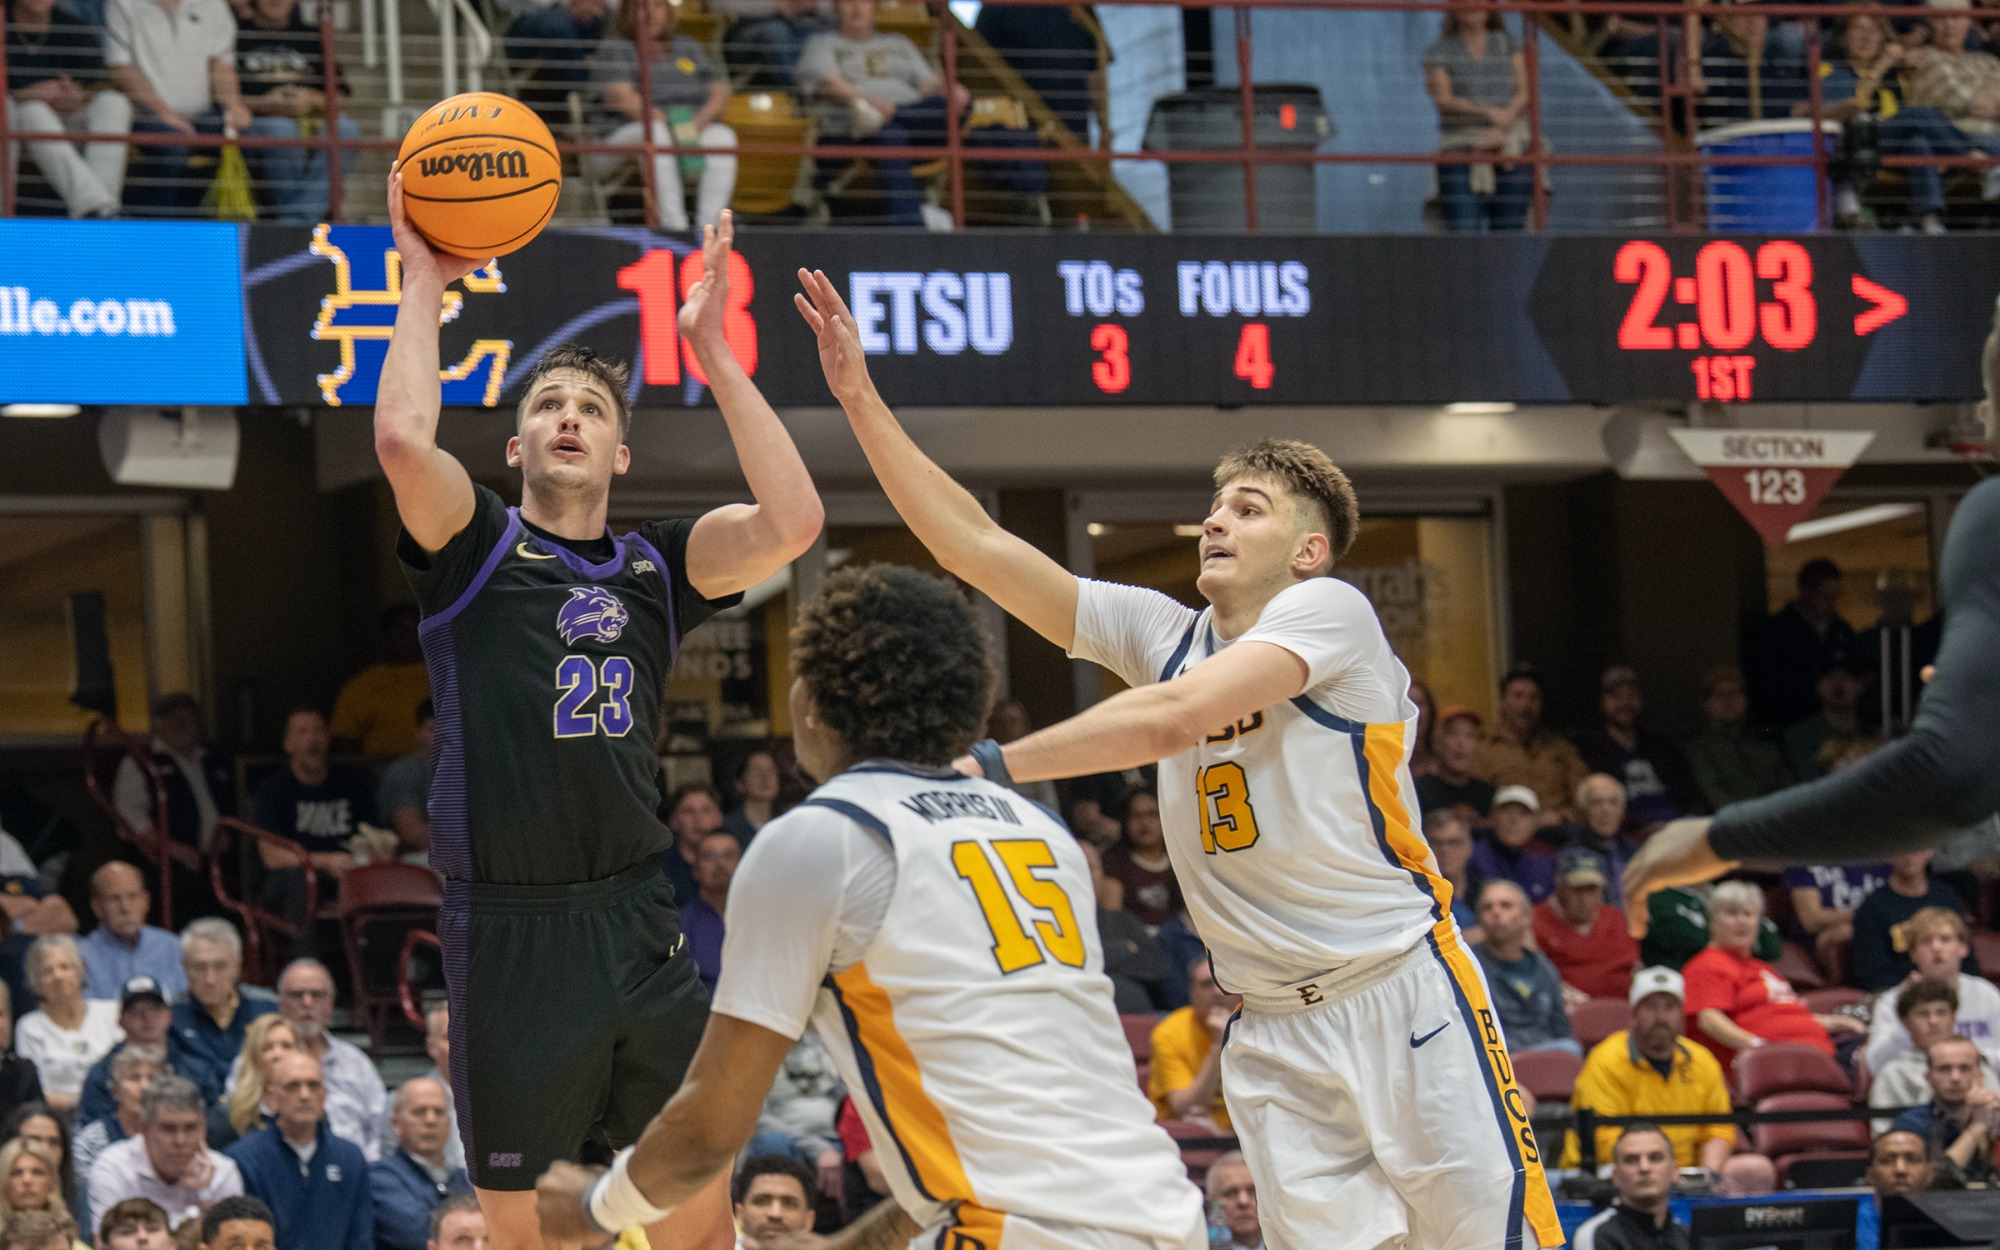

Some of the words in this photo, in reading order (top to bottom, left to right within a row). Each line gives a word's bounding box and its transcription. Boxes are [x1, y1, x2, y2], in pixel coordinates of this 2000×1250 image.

[419, 149, 530, 182] Wilson
[848, 270, 1014, 356] ETSU
[1056, 260, 1146, 318] TOs
[1177, 260, 1312, 318] FOULS
[1613, 240, 1818, 351] 2:03
[1090, 322, 1132, 393] 3
[1233, 322, 1276, 390] 4
[1691, 355, 1757, 402] 1ST
[1721, 435, 1823, 460] SECTION
[1743, 468, 1807, 505] 123
[553, 654, 635, 739] 23
[899, 791, 998, 826] MORRIS
[989, 795, 1023, 827] III
[1196, 760, 1261, 856] 13
[951, 839, 1087, 976] 15
[1477, 1008, 1539, 1164] BUCS
